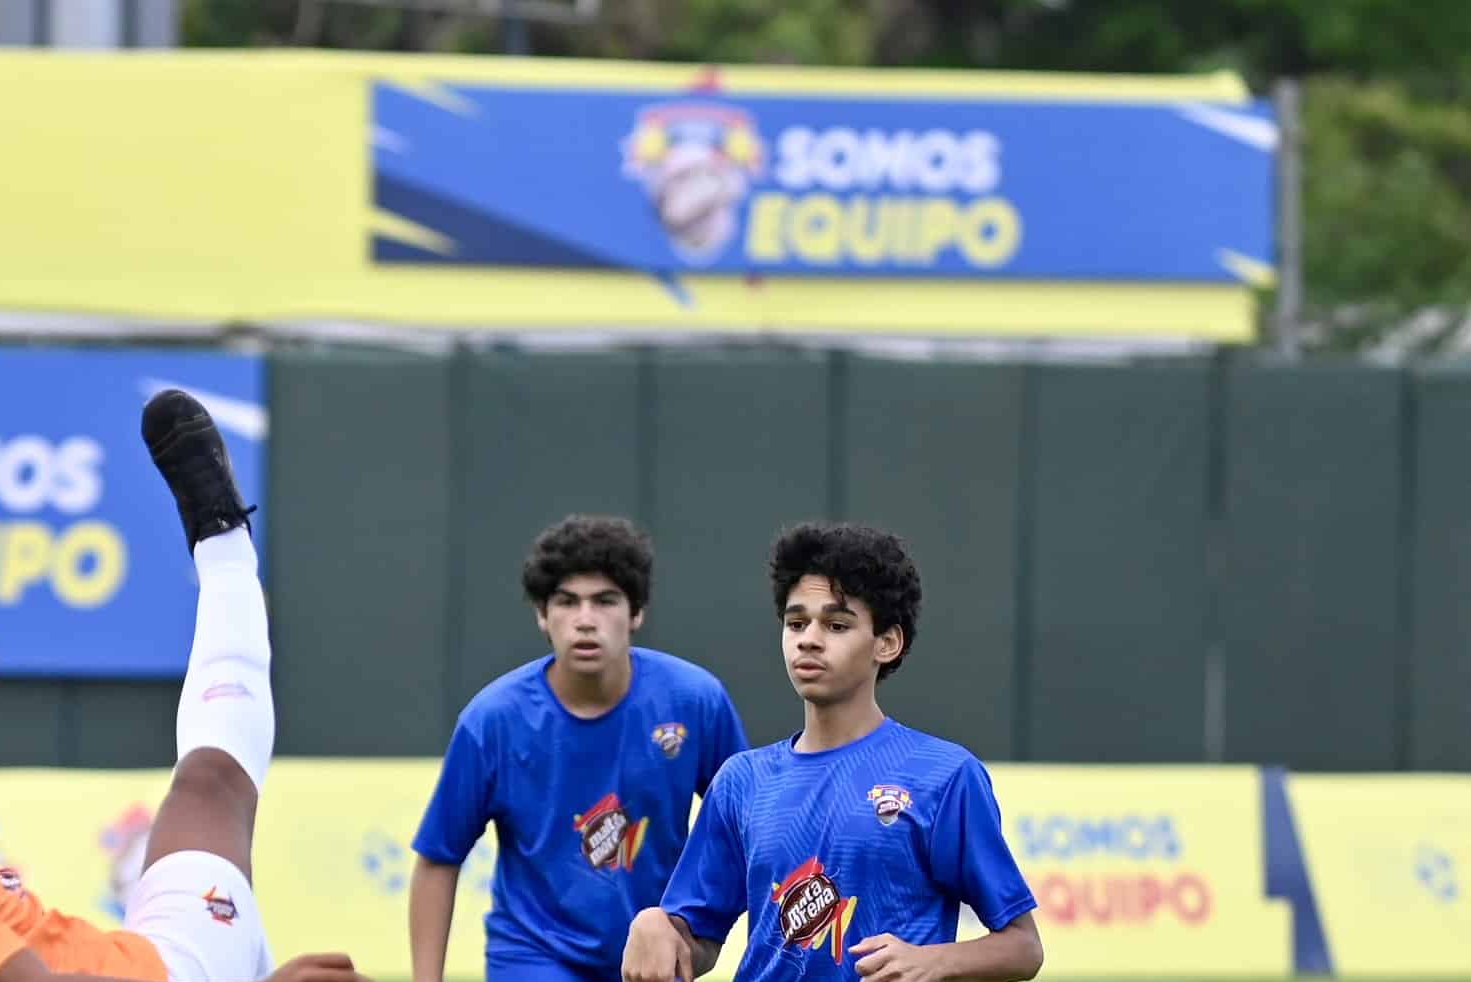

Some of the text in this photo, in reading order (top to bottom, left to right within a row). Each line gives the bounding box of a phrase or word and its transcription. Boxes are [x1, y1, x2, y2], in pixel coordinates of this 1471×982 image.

[777, 126, 1001, 192] SOMOS
[747, 193, 1023, 266] EQUIPO
[1016, 814, 1183, 859] SOMOS
[1032, 873, 1213, 923] QUIPO
